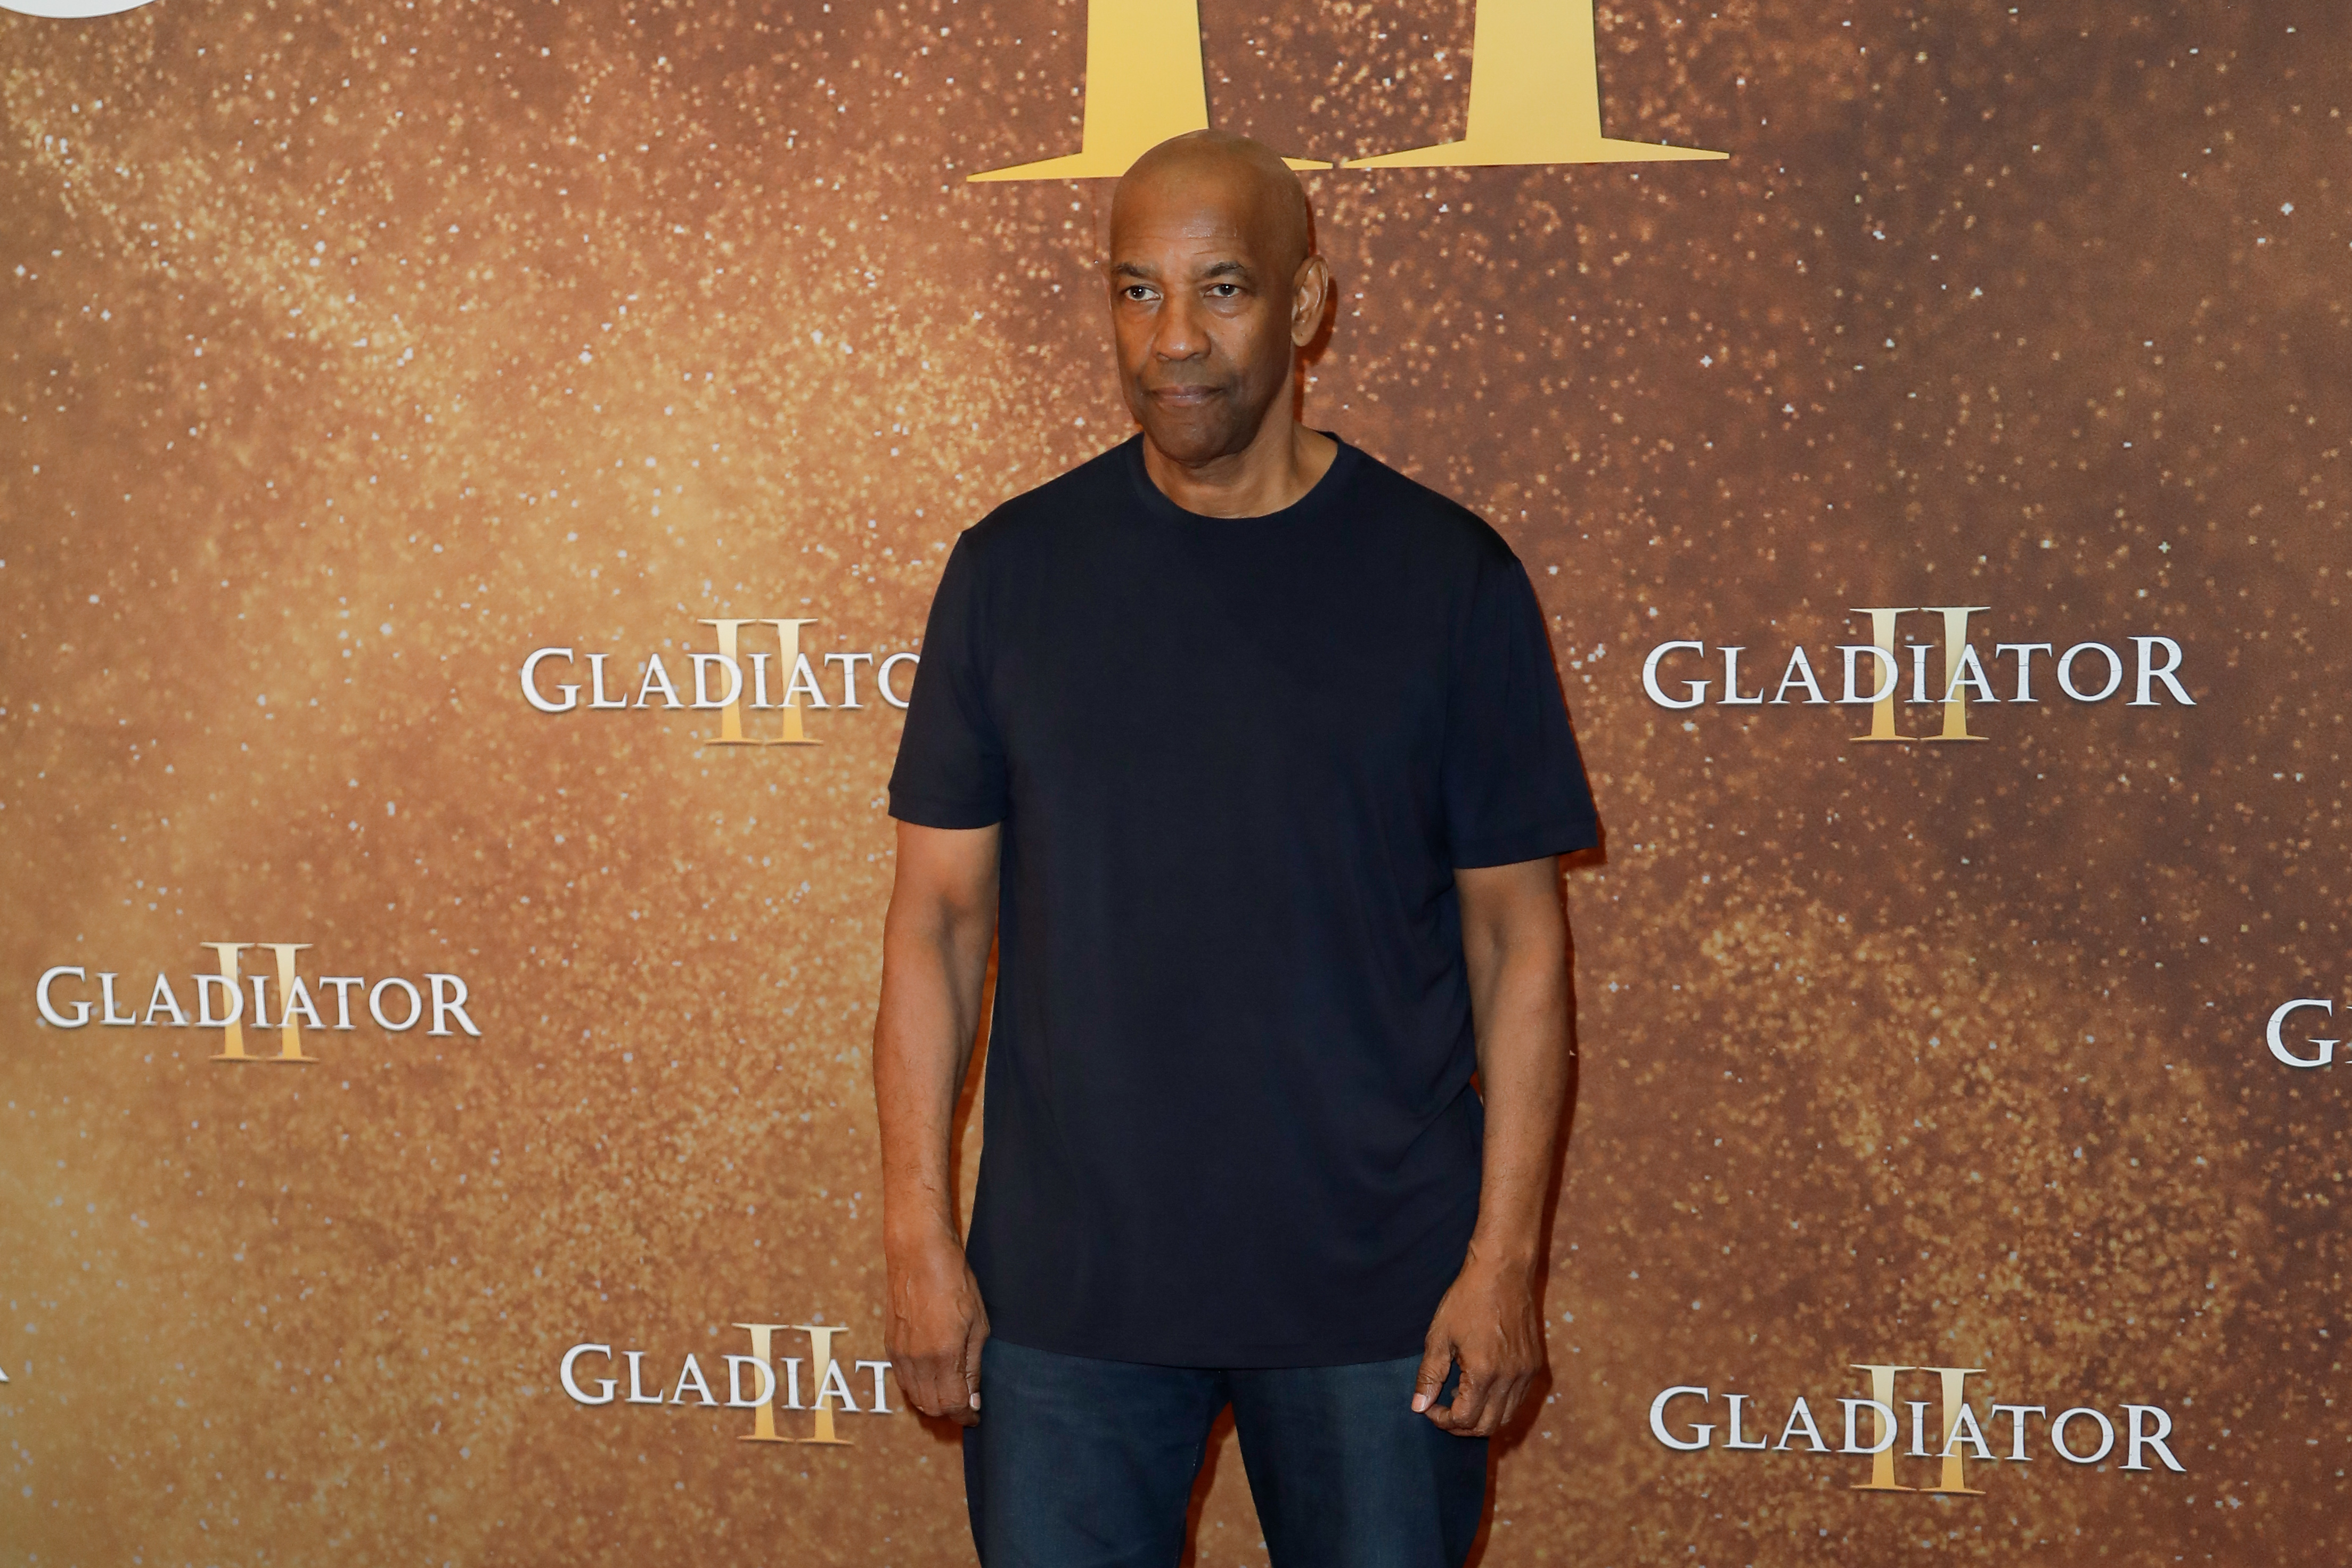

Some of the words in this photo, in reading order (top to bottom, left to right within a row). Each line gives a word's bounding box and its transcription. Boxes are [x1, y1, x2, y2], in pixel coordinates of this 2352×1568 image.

[520, 647, 921, 712] GLADIATO
[698, 618, 824, 745] II
[1642, 636, 2197, 708] GLADIATOR
[1849, 606, 1991, 741] II
[36, 966, 481, 1036] GLADIATOR
[200, 942, 319, 1061] II
[560, 1343, 893, 1414] GLADIAT
[731, 1322, 853, 1444] II
[1649, 1386, 2186, 1472] GLADIATOR
[1850, 1364, 1987, 1493] II
